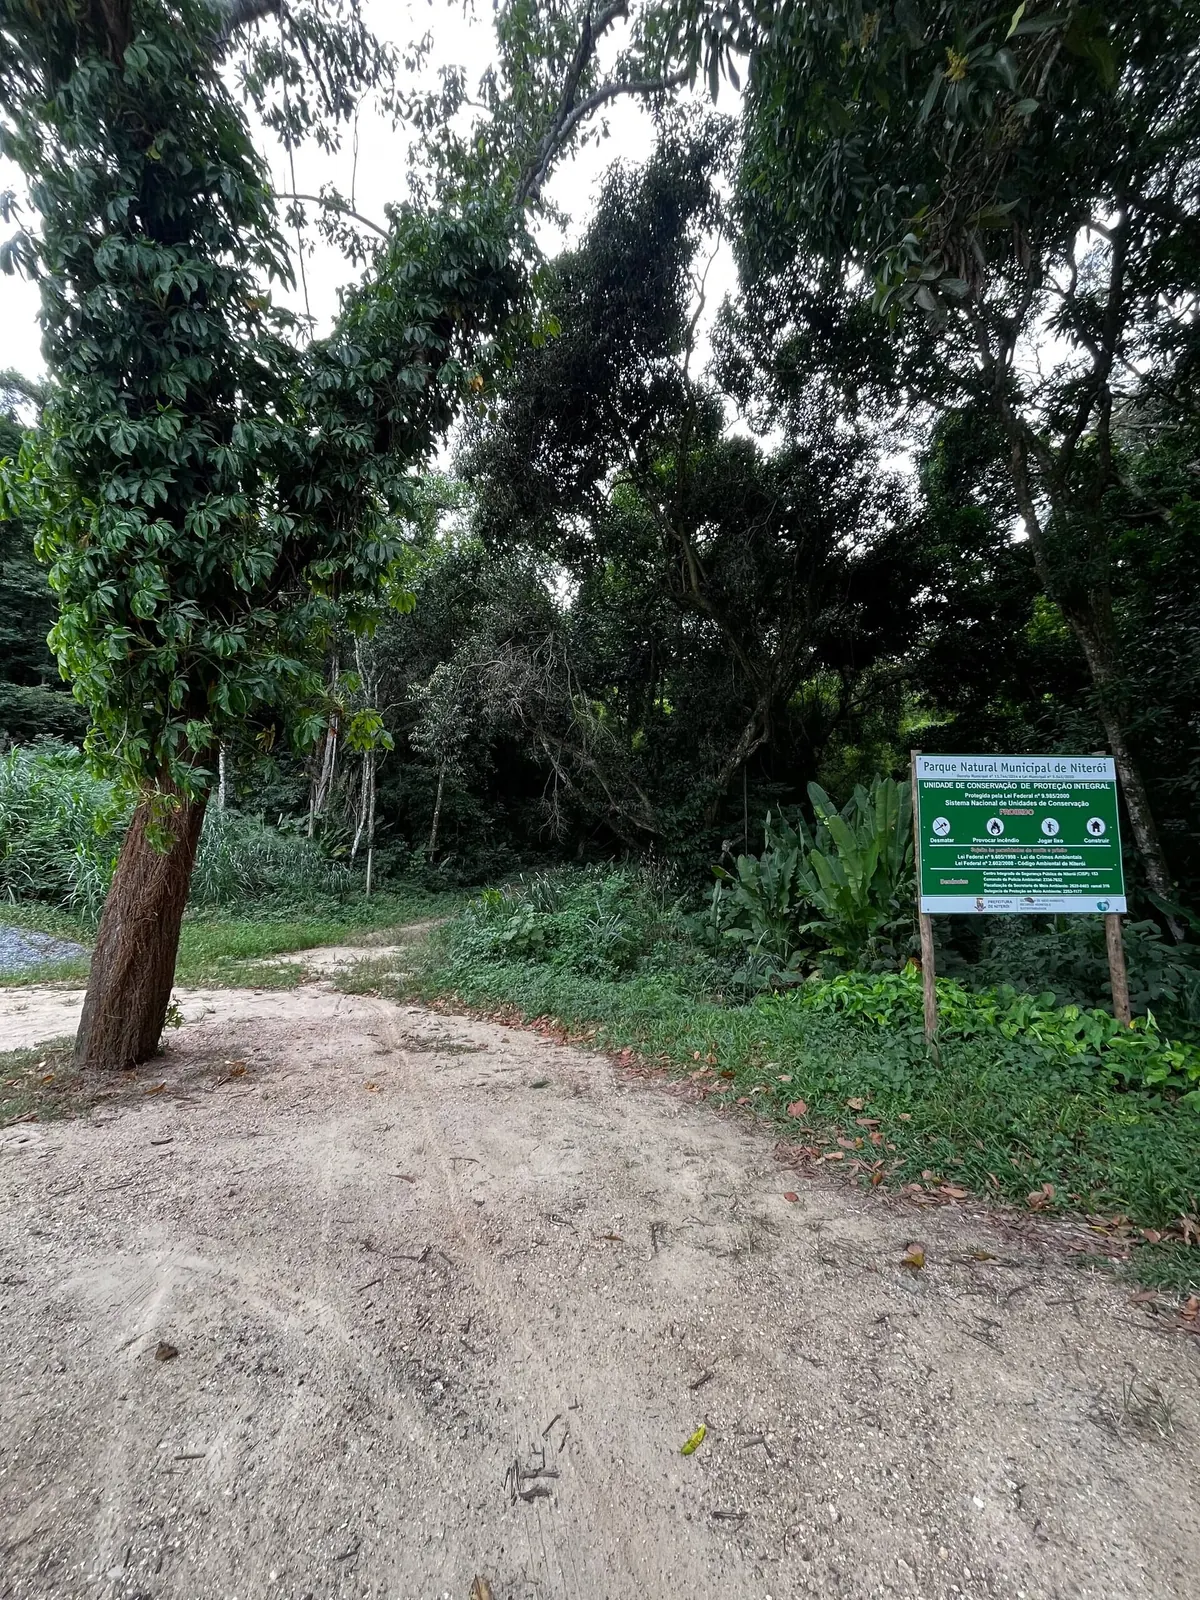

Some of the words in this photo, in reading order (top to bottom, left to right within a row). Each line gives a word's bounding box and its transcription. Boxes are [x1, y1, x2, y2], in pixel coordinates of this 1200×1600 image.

[924, 762, 956, 773] Parque
[961, 762, 997, 772] Natural
[1001, 762, 1050, 774] Municipal
[1055, 763, 1066, 772] de
[1071, 763, 1107, 772] Niterói
[967, 782, 1017, 790] CONSERVAÇÃO
[1034, 782, 1072, 790] PROTEÇÃO
